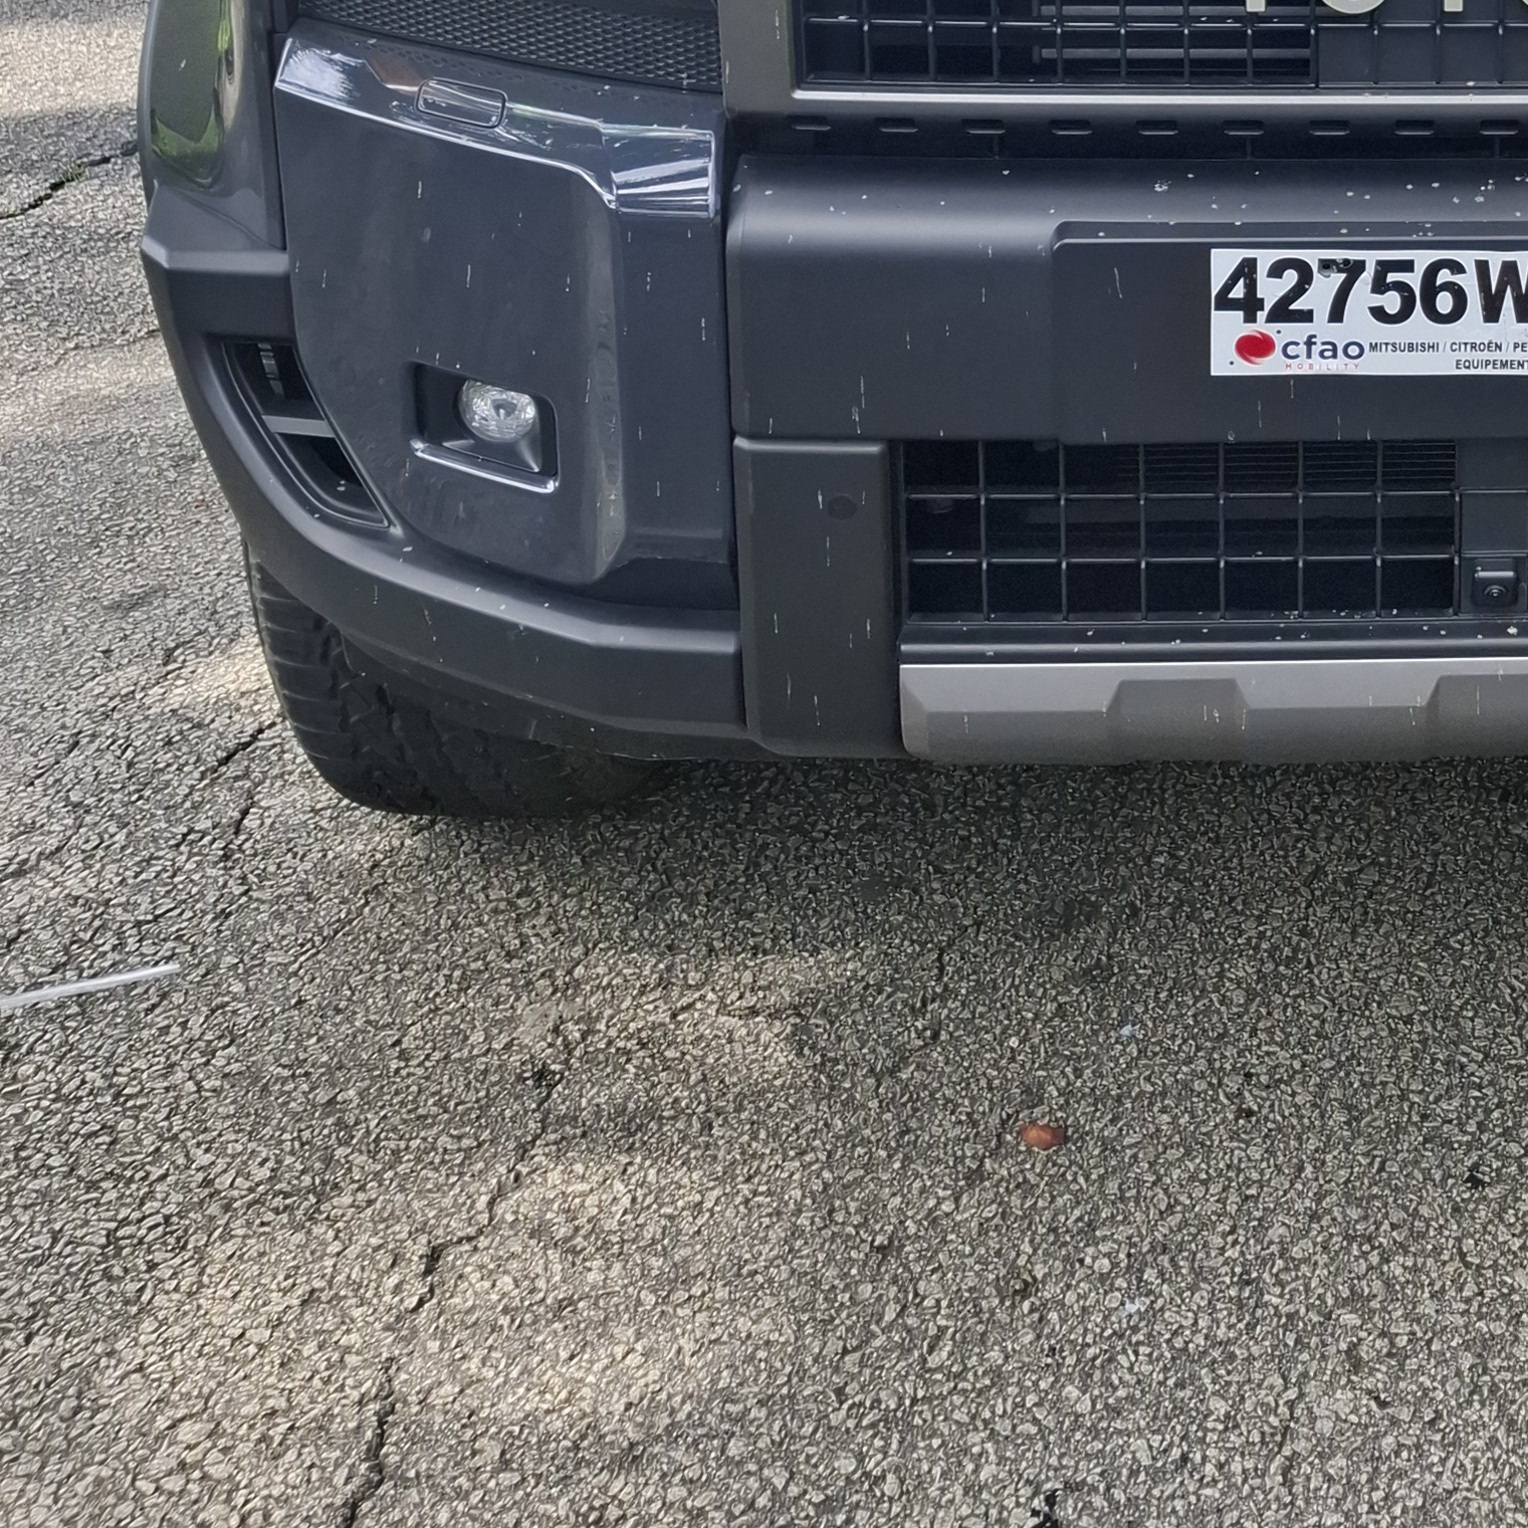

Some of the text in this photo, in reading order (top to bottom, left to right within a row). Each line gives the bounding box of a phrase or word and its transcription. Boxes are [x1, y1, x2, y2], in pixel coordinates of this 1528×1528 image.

[1281, 333, 1366, 361] cfao
[1368, 341, 1440, 354] MITSUBISHI
[1285, 362, 1360, 371] MOBILITY
